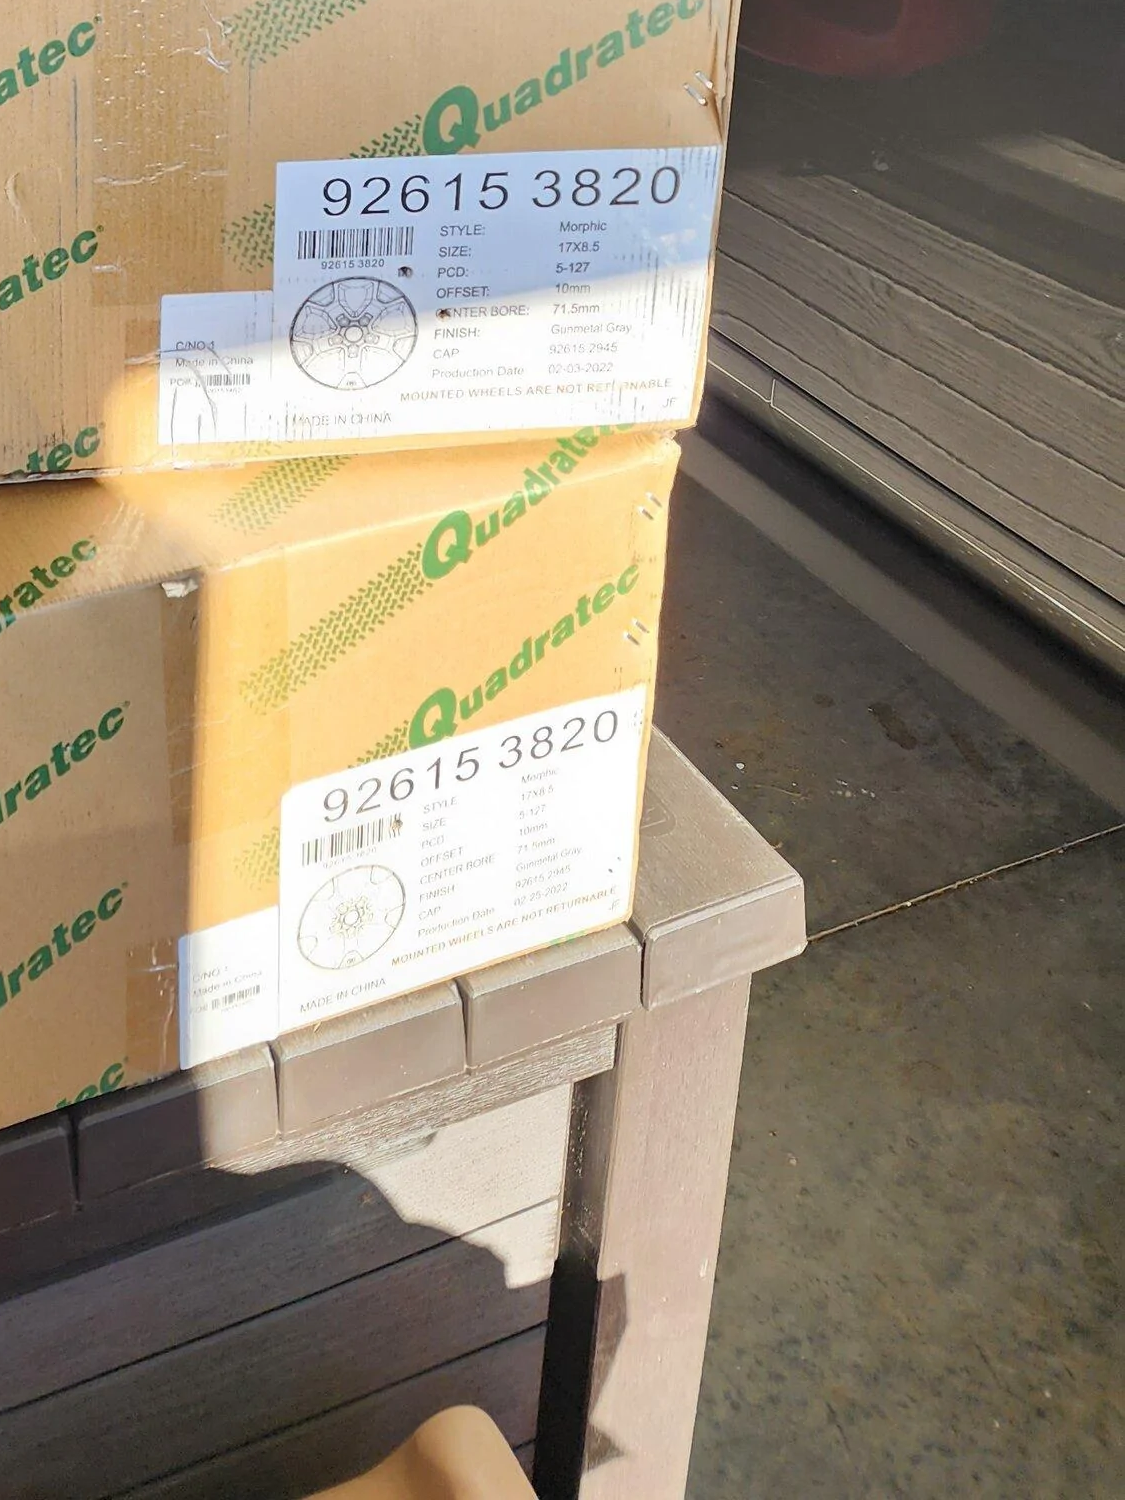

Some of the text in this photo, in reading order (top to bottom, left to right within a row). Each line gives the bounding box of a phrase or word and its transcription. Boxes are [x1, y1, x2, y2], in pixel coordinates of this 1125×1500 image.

[322, 164, 682, 217] 92615 3820
[439, 220, 608, 237] STYLE: Morphic
[438, 241, 600, 258] SIZE: 17X8.5
[321, 258, 385, 270] 92615 3820
[437, 262, 591, 278] PCD: 5-127
[436, 282, 591, 299] OFFSET: 10mm
[491, 305, 530, 317] BORE:
[552, 303, 601, 315] 71.5mm
[434, 322, 633, 340] FINISH: Gunmetal Gray
[431, 366, 494, 379] Production
[497, 365, 525, 377] Date
[400, 388, 465, 403] MOUNTED
[469, 385, 523, 399] WHEELS
[526, 384, 552, 396] ARE
[555, 383, 583, 395] NOT
[334, 413, 347, 426] IN
[350, 412, 393, 425] CHINA
[408, 564, 641, 750] Quadratec
[322, 708, 619, 824] 92615 3820
[520, 910, 545, 924] NOT
[299, 996, 334, 1014] MADE
[351, 977, 388, 997] CHINA
